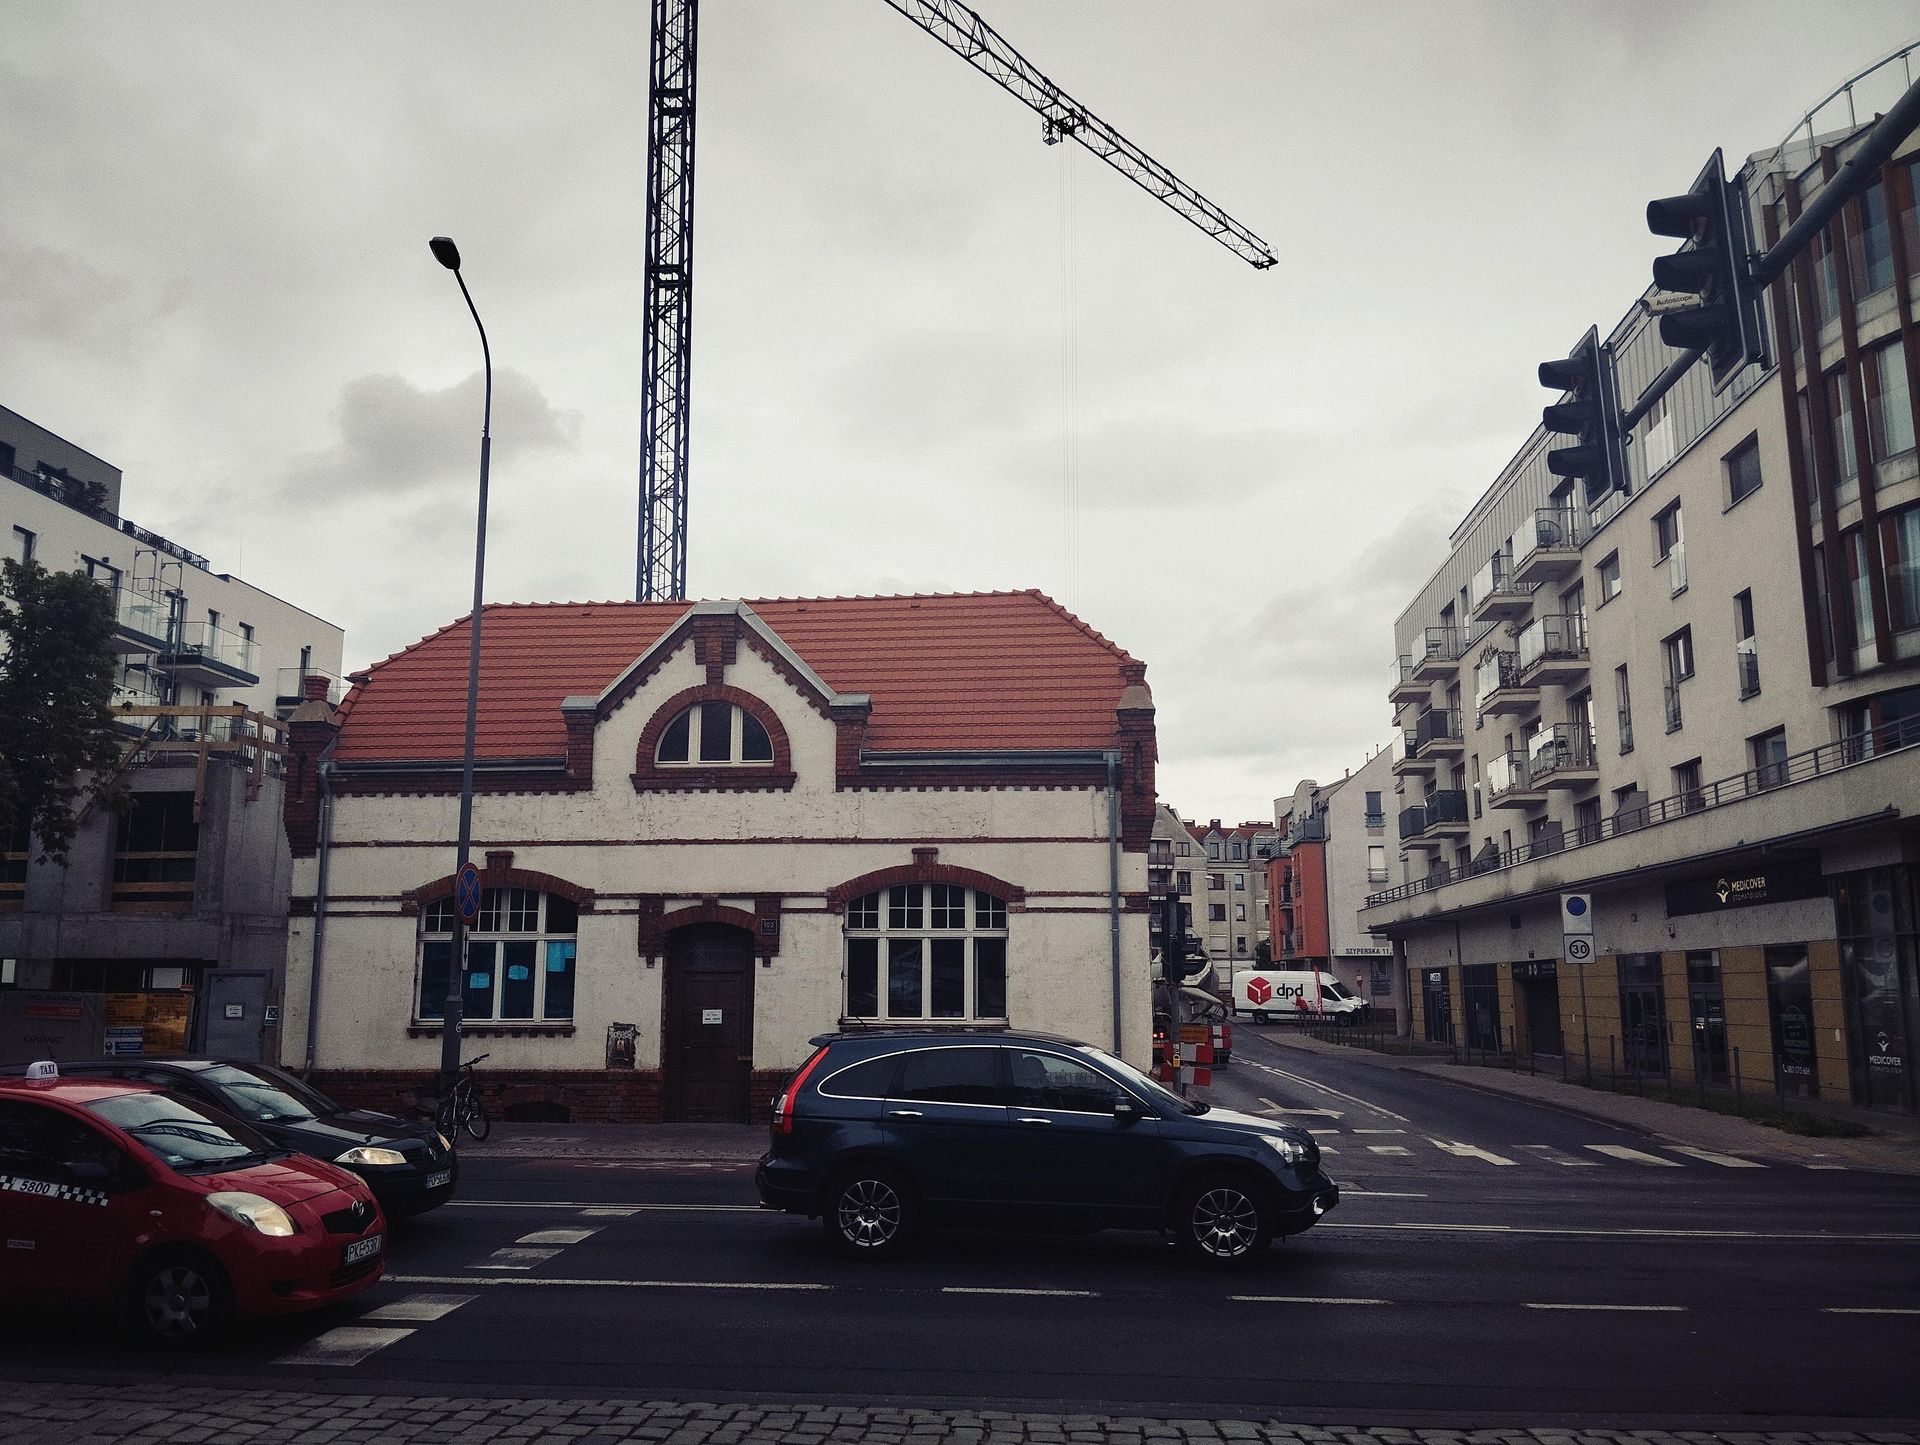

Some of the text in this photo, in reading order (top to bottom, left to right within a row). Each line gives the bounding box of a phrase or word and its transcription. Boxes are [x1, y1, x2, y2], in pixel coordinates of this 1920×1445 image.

[1656, 295, 1693, 306] Autoscope
[1731, 877, 1766, 892] MEDICOVER
[1572, 944, 1587, 954] 30
[1276, 983, 1304, 999] dpd
[1869, 1055, 1902, 1066] MEDICOVER
[40, 1064, 56, 1075] TAXI
[20, 1180, 50, 1194] 5800
[348, 1240, 365, 1261] PKE
